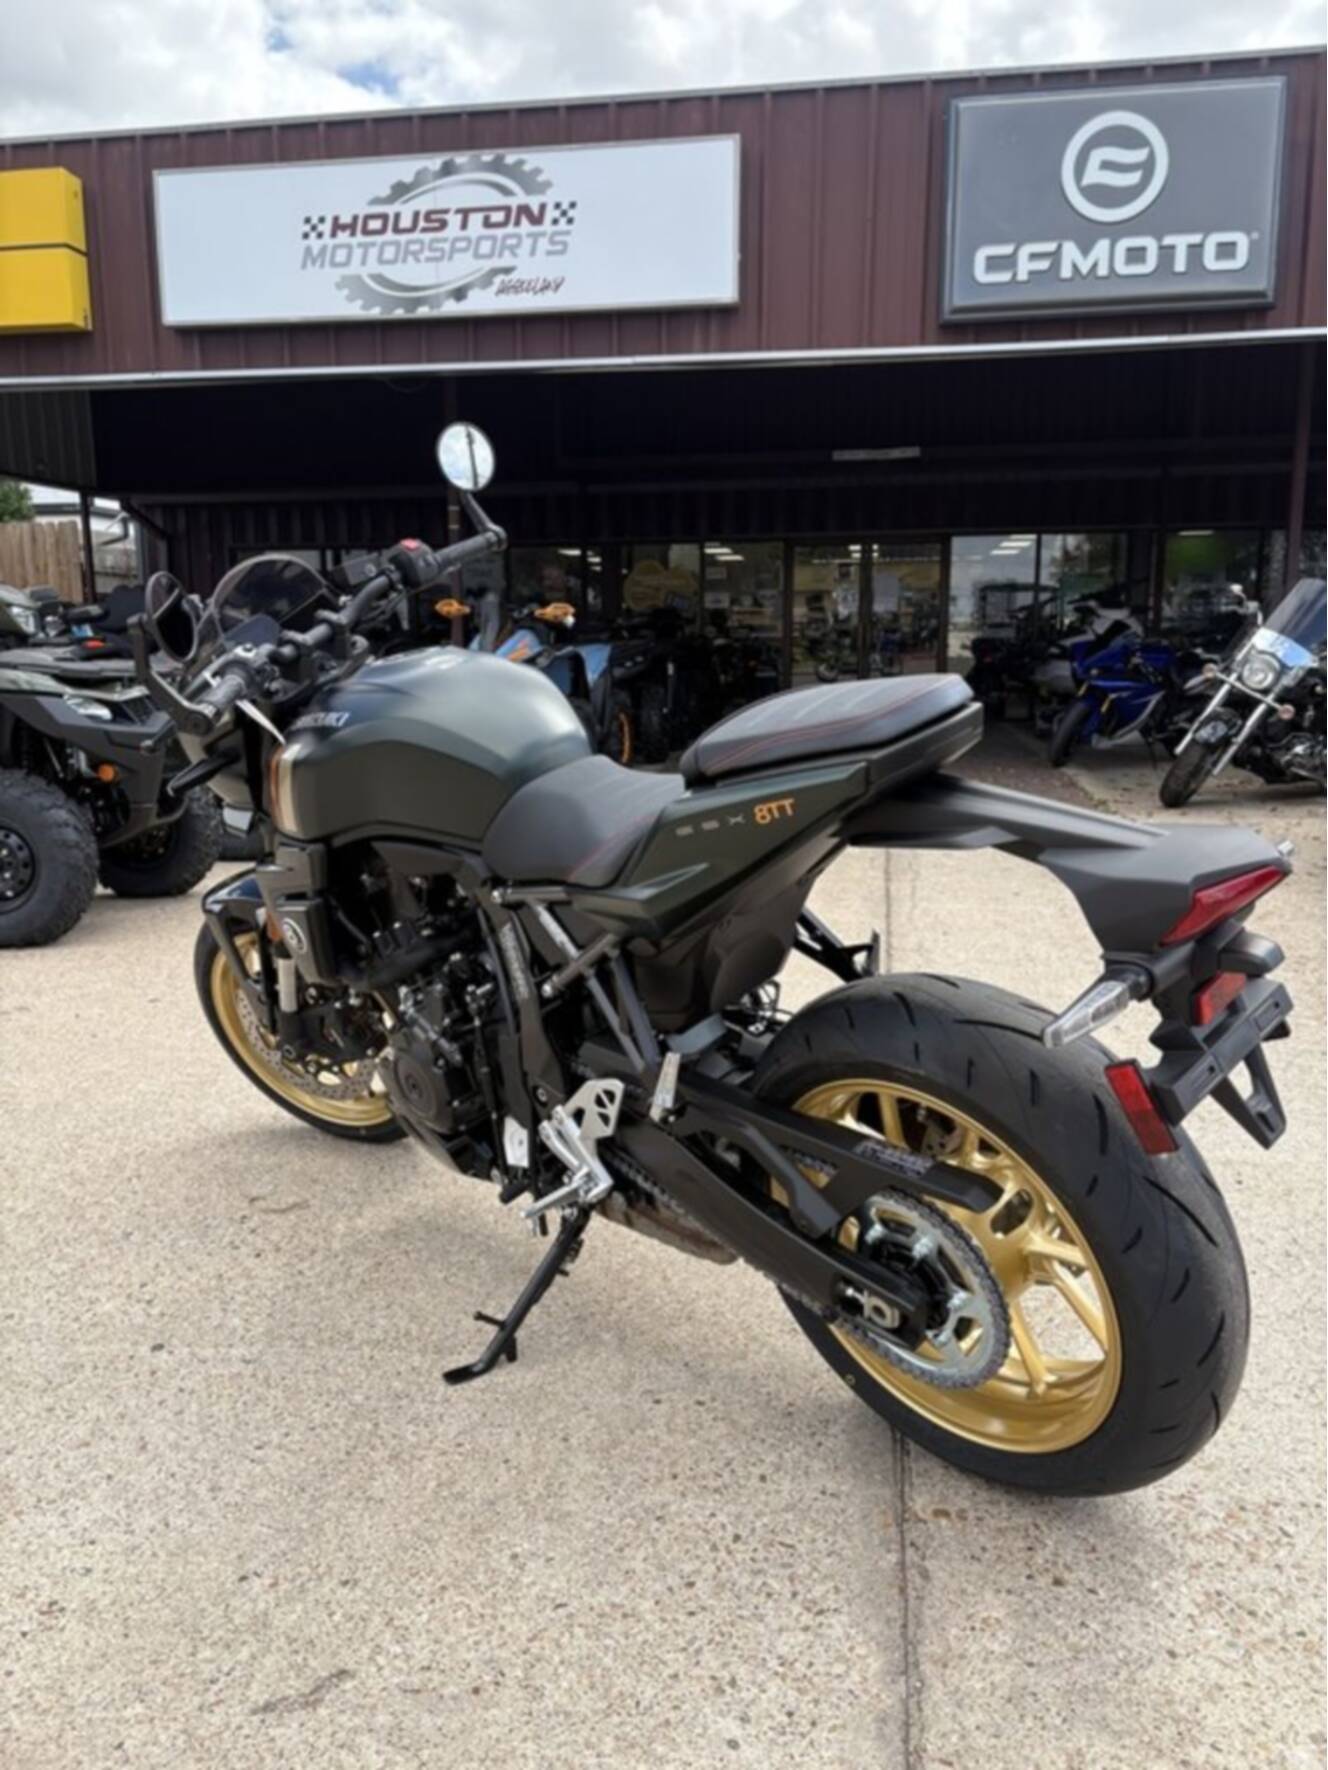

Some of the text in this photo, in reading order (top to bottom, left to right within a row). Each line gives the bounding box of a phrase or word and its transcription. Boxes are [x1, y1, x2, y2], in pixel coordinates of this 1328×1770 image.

[330, 203, 547, 238] HOUSTON
[301, 230, 572, 270] MOTORSPORTS
[974, 231, 1249, 284] CFMOTO
[754, 798, 795, 824] 8TT
